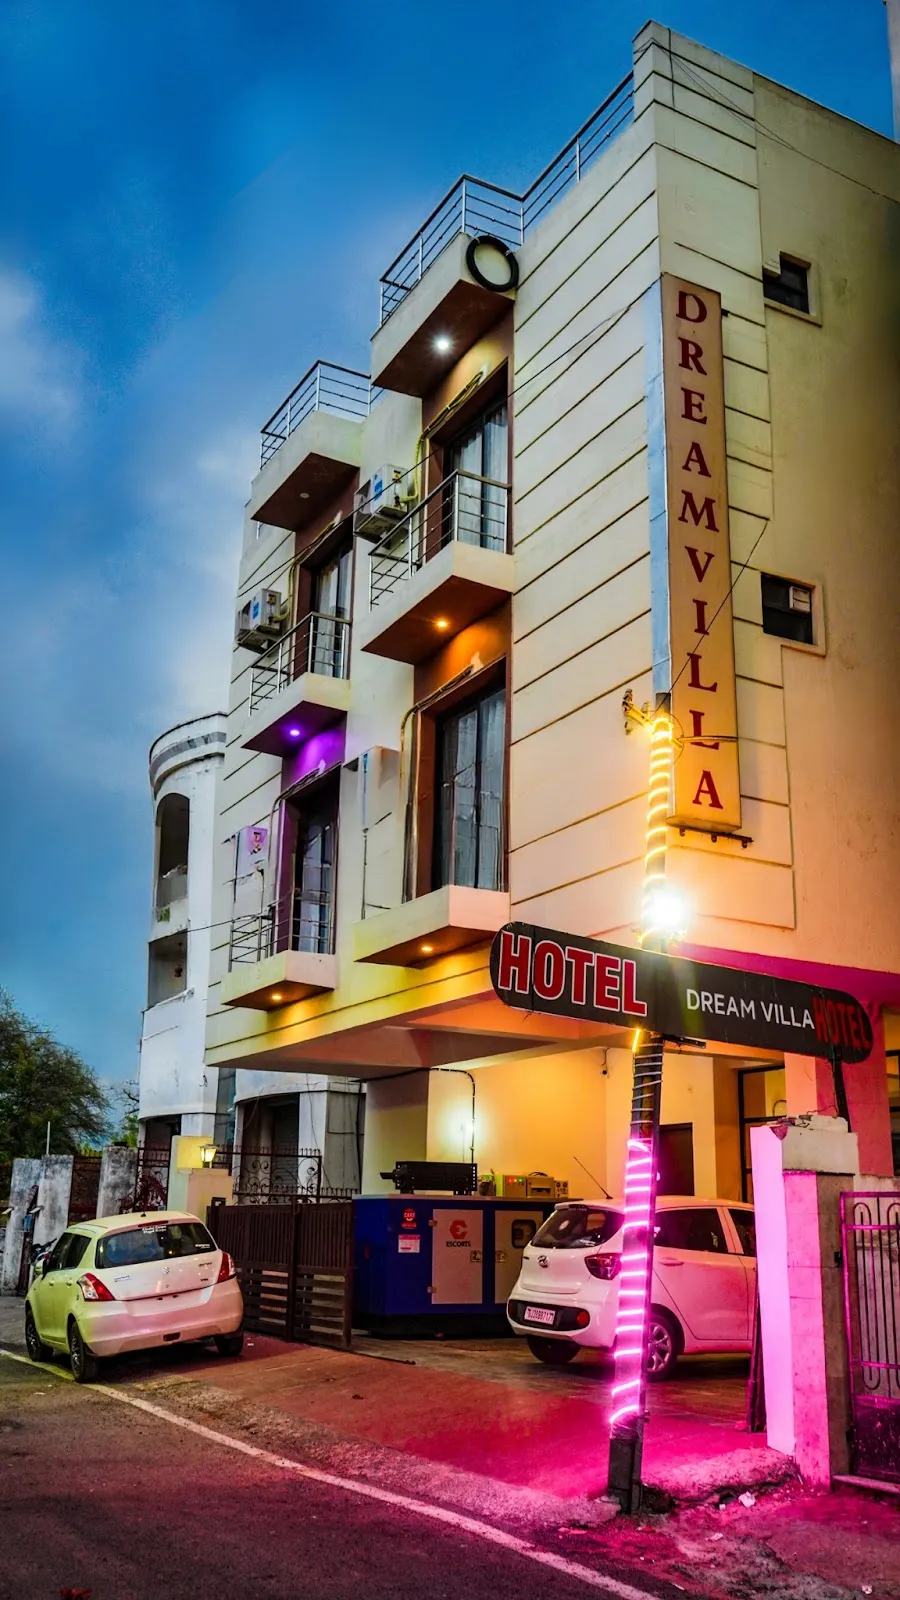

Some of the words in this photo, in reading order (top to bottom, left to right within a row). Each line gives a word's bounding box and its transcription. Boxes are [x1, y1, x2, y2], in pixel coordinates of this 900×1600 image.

[498, 930, 647, 1017] HOTEL
[685, 987, 757, 1021] DREAM
[759, 1000, 817, 1031] VILLA
[811, 995, 870, 1050] HOTEL
[446, 1240, 471, 1248] ESCORTS
